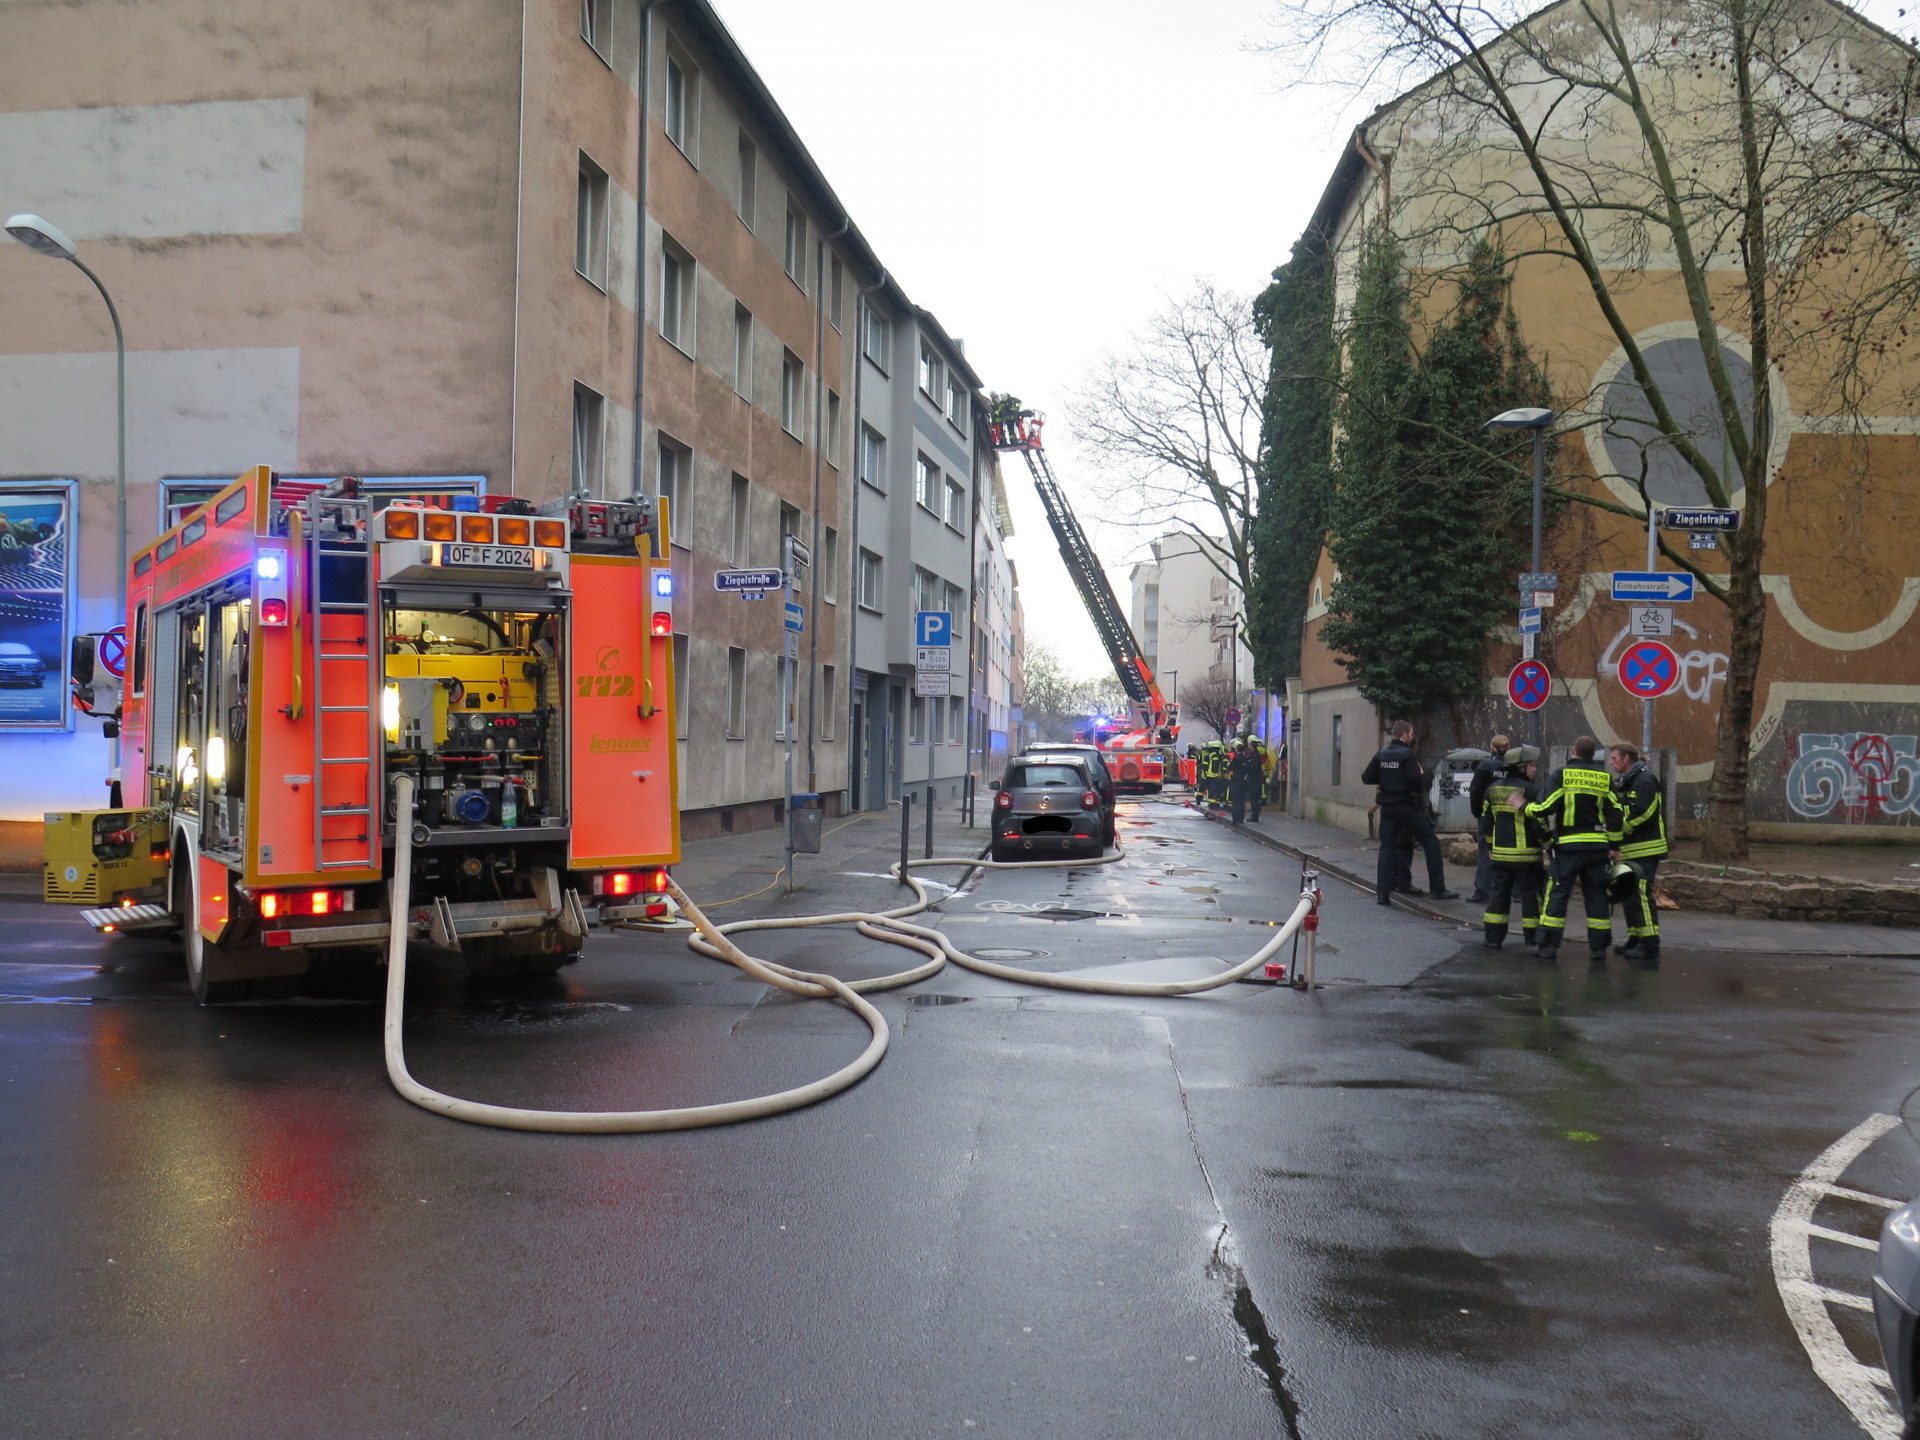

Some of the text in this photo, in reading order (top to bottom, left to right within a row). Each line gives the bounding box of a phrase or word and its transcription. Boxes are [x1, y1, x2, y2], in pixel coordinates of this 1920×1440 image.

[1675, 513, 1730, 526] Ziegelstraße
[452, 547, 532, 566] OF F 2024
[725, 574, 771, 587] Ziegelstraße
[1616, 582, 1670, 590] Einbahnstraße
[924, 615, 943, 642] P
[576, 674, 635, 698] 112
[589, 733, 653, 754] Lentner
[1493, 770, 1508, 778] POLI
[1564, 770, 1609, 781] FEUERWEHR
[1564, 778, 1609, 790] OFFENBACH
